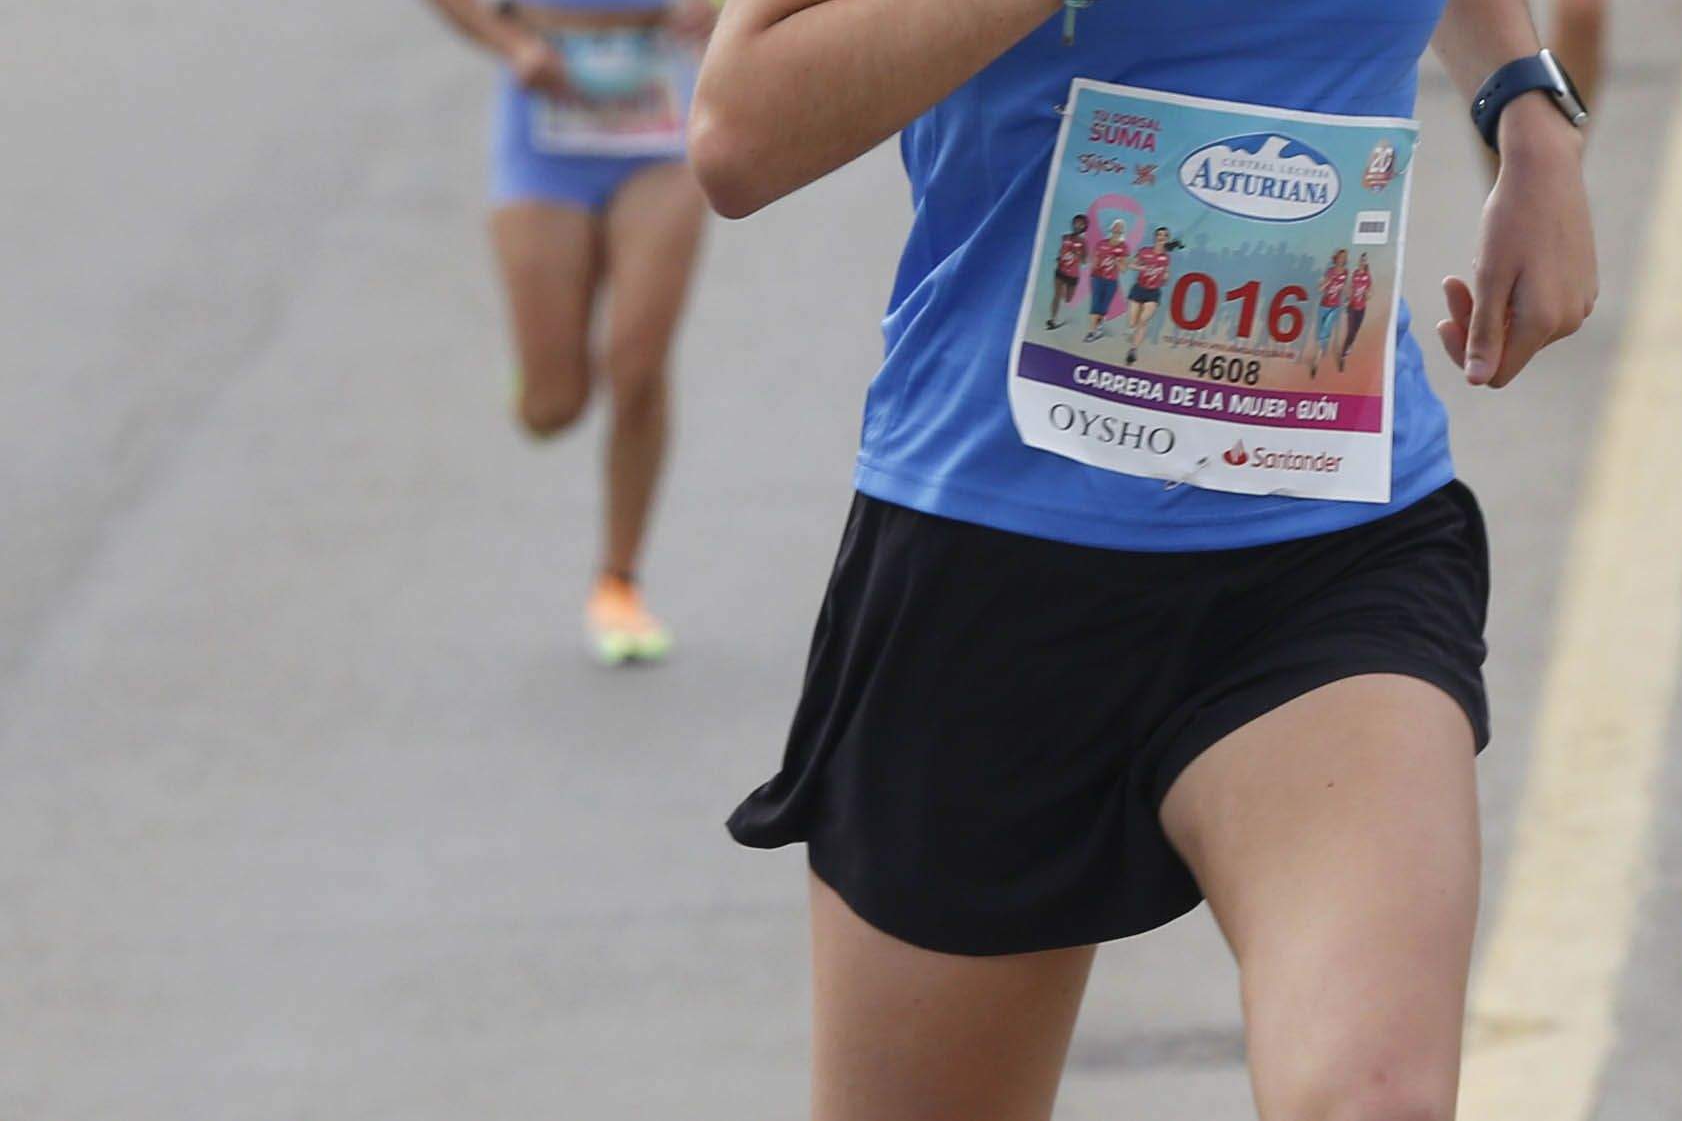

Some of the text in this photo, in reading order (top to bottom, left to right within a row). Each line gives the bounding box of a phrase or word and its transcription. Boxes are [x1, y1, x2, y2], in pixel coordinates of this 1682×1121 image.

[1088, 122, 1157, 152] SUMA
[1186, 157, 1329, 205] ASTURIANA
[1170, 271, 1310, 344] 016
[1190, 352, 1262, 386] 4608
[1073, 365, 1164, 402] CARRERA
[1168, 385, 1197, 407] DE
[1198, 389, 1224, 412] LA
[1228, 393, 1288, 419] MUJER
[1296, 395, 1339, 422] GIJÓN
[1048, 402, 1176, 456] OYSHO
[1251, 447, 1344, 473] Santander
